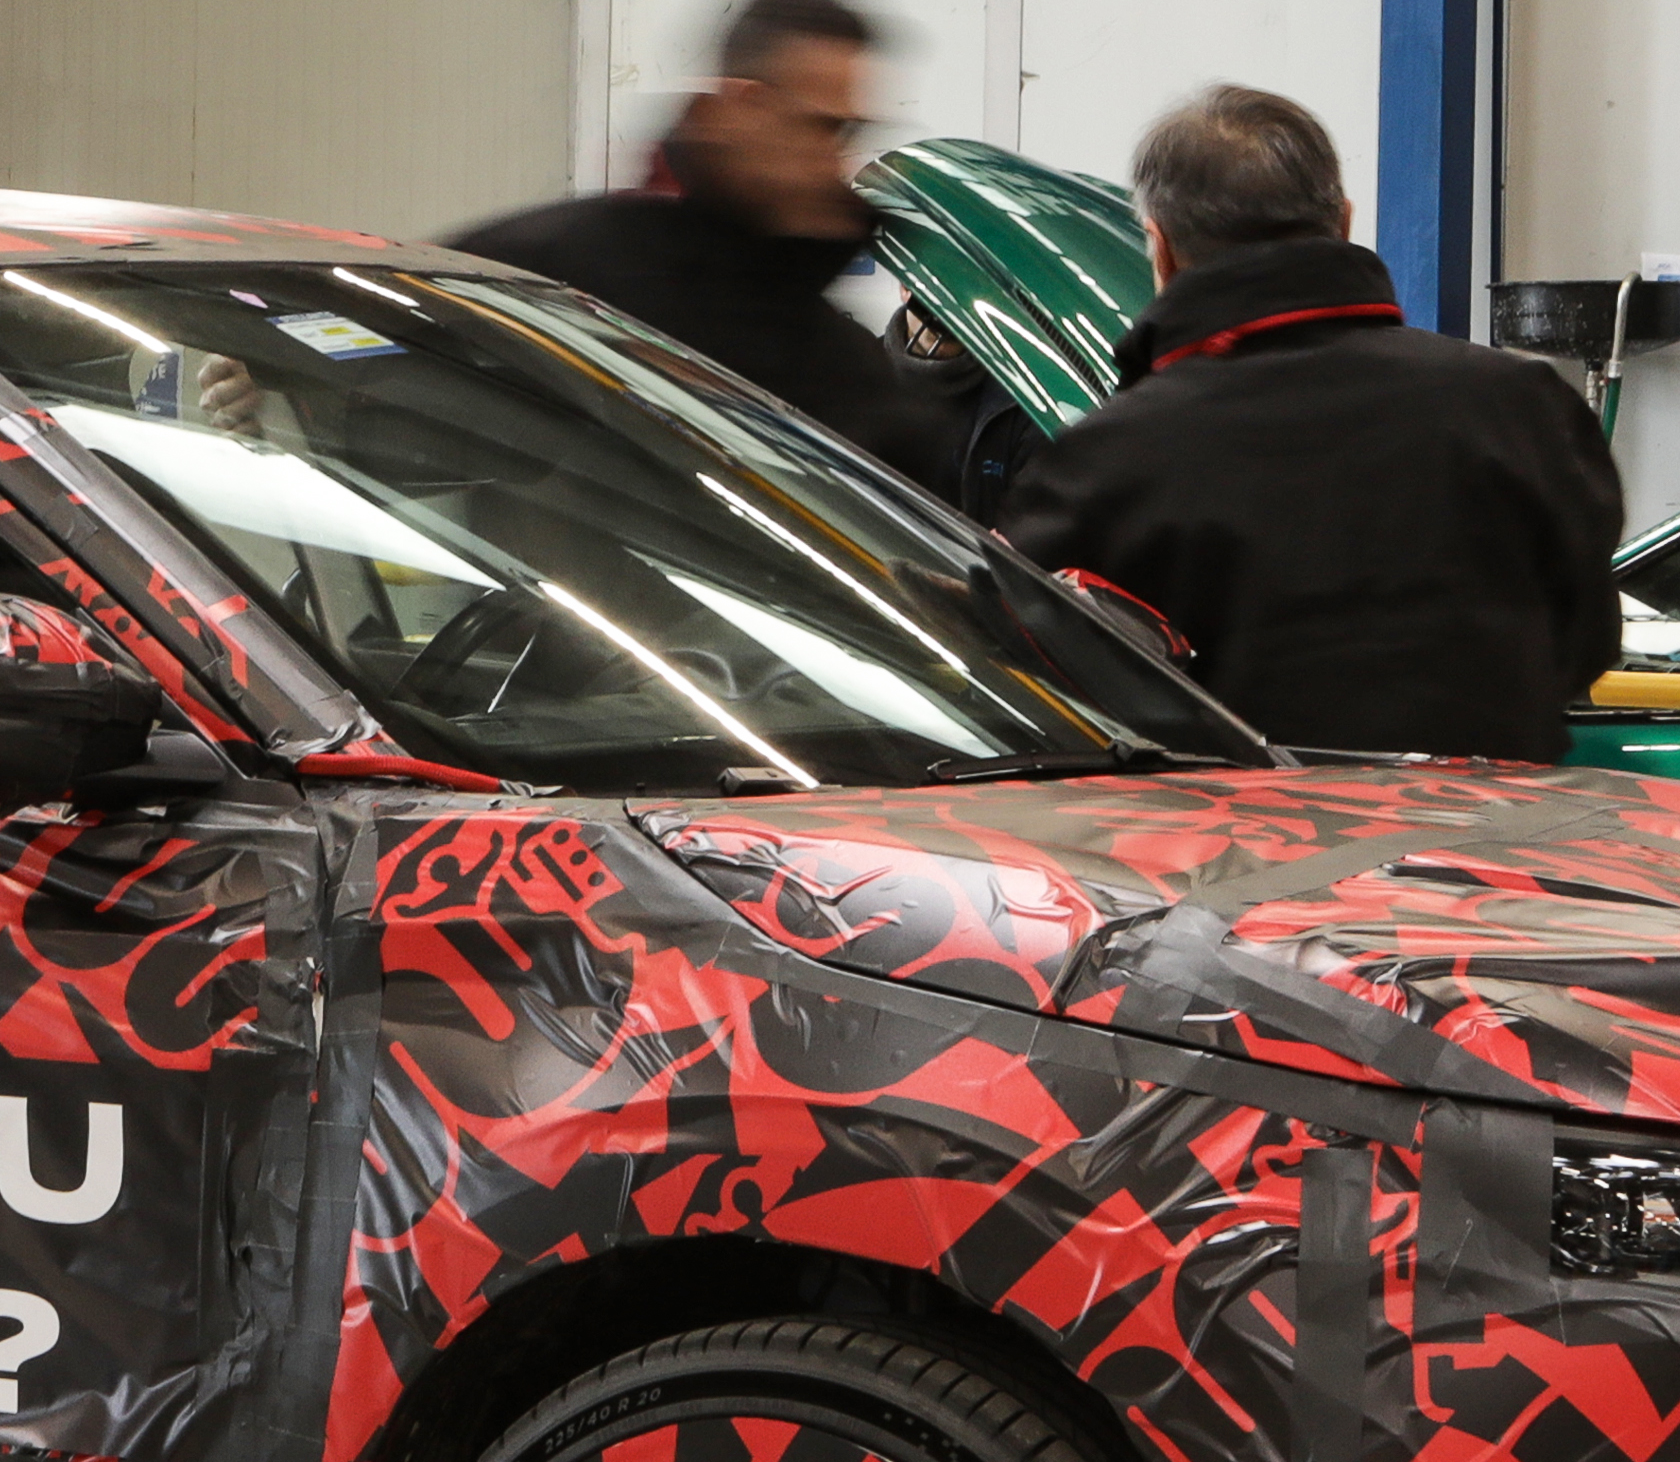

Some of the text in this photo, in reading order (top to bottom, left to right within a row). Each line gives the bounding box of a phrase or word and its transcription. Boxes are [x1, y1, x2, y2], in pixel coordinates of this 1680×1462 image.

[543, 1386, 663, 1456] 225/40 R 20
